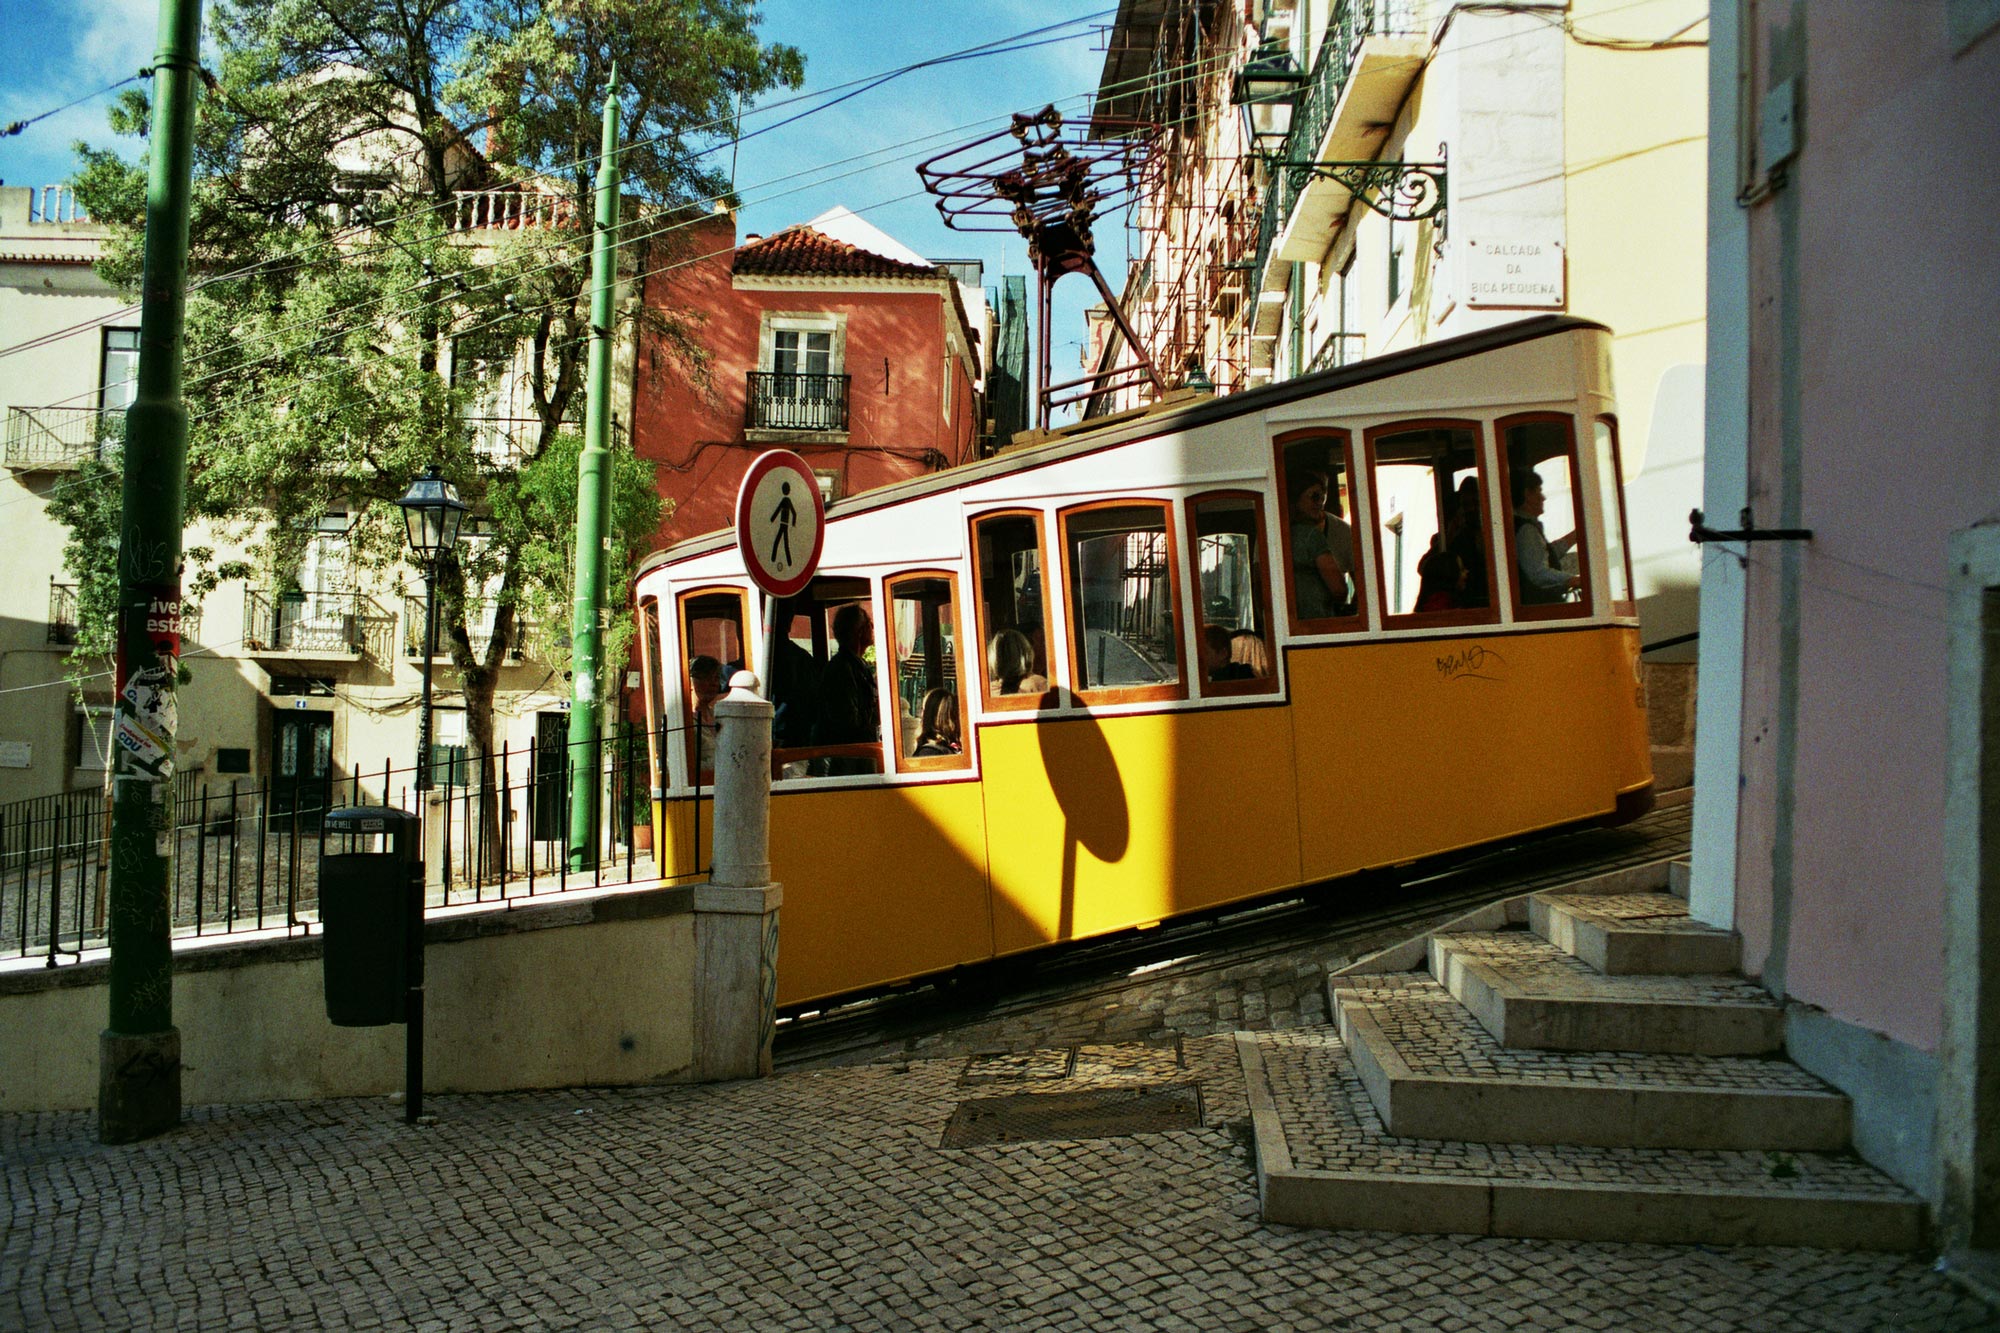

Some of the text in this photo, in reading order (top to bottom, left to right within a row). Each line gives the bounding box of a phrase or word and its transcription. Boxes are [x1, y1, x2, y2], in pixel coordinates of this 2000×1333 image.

[1506, 263, 1521, 274] DA
[1471, 282, 1556, 294] BICA PEQUENA
[118, 731, 142, 752] CDU
